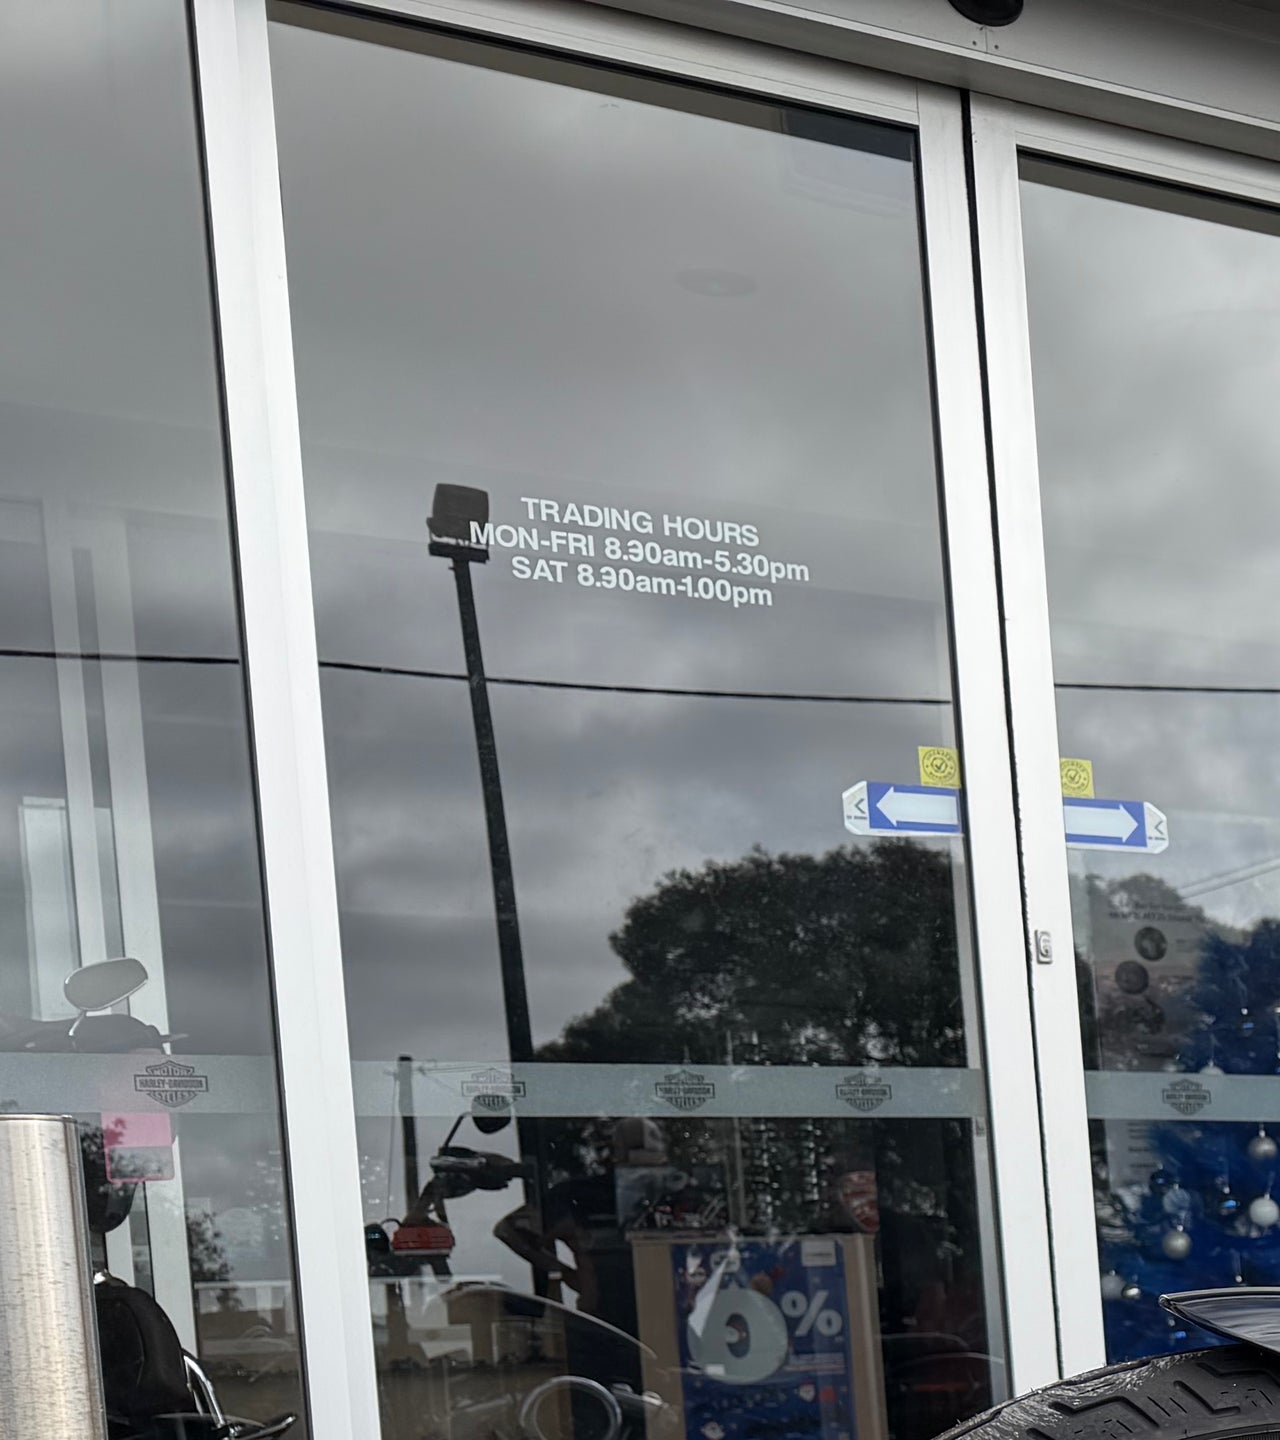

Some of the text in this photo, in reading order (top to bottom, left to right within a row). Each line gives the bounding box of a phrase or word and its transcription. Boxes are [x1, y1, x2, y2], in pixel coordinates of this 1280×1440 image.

[469, 520, 596, 557] MON-FRI
[520, 496, 760, 547] TRADING HOURS
[511, 556, 568, 583] SAT
